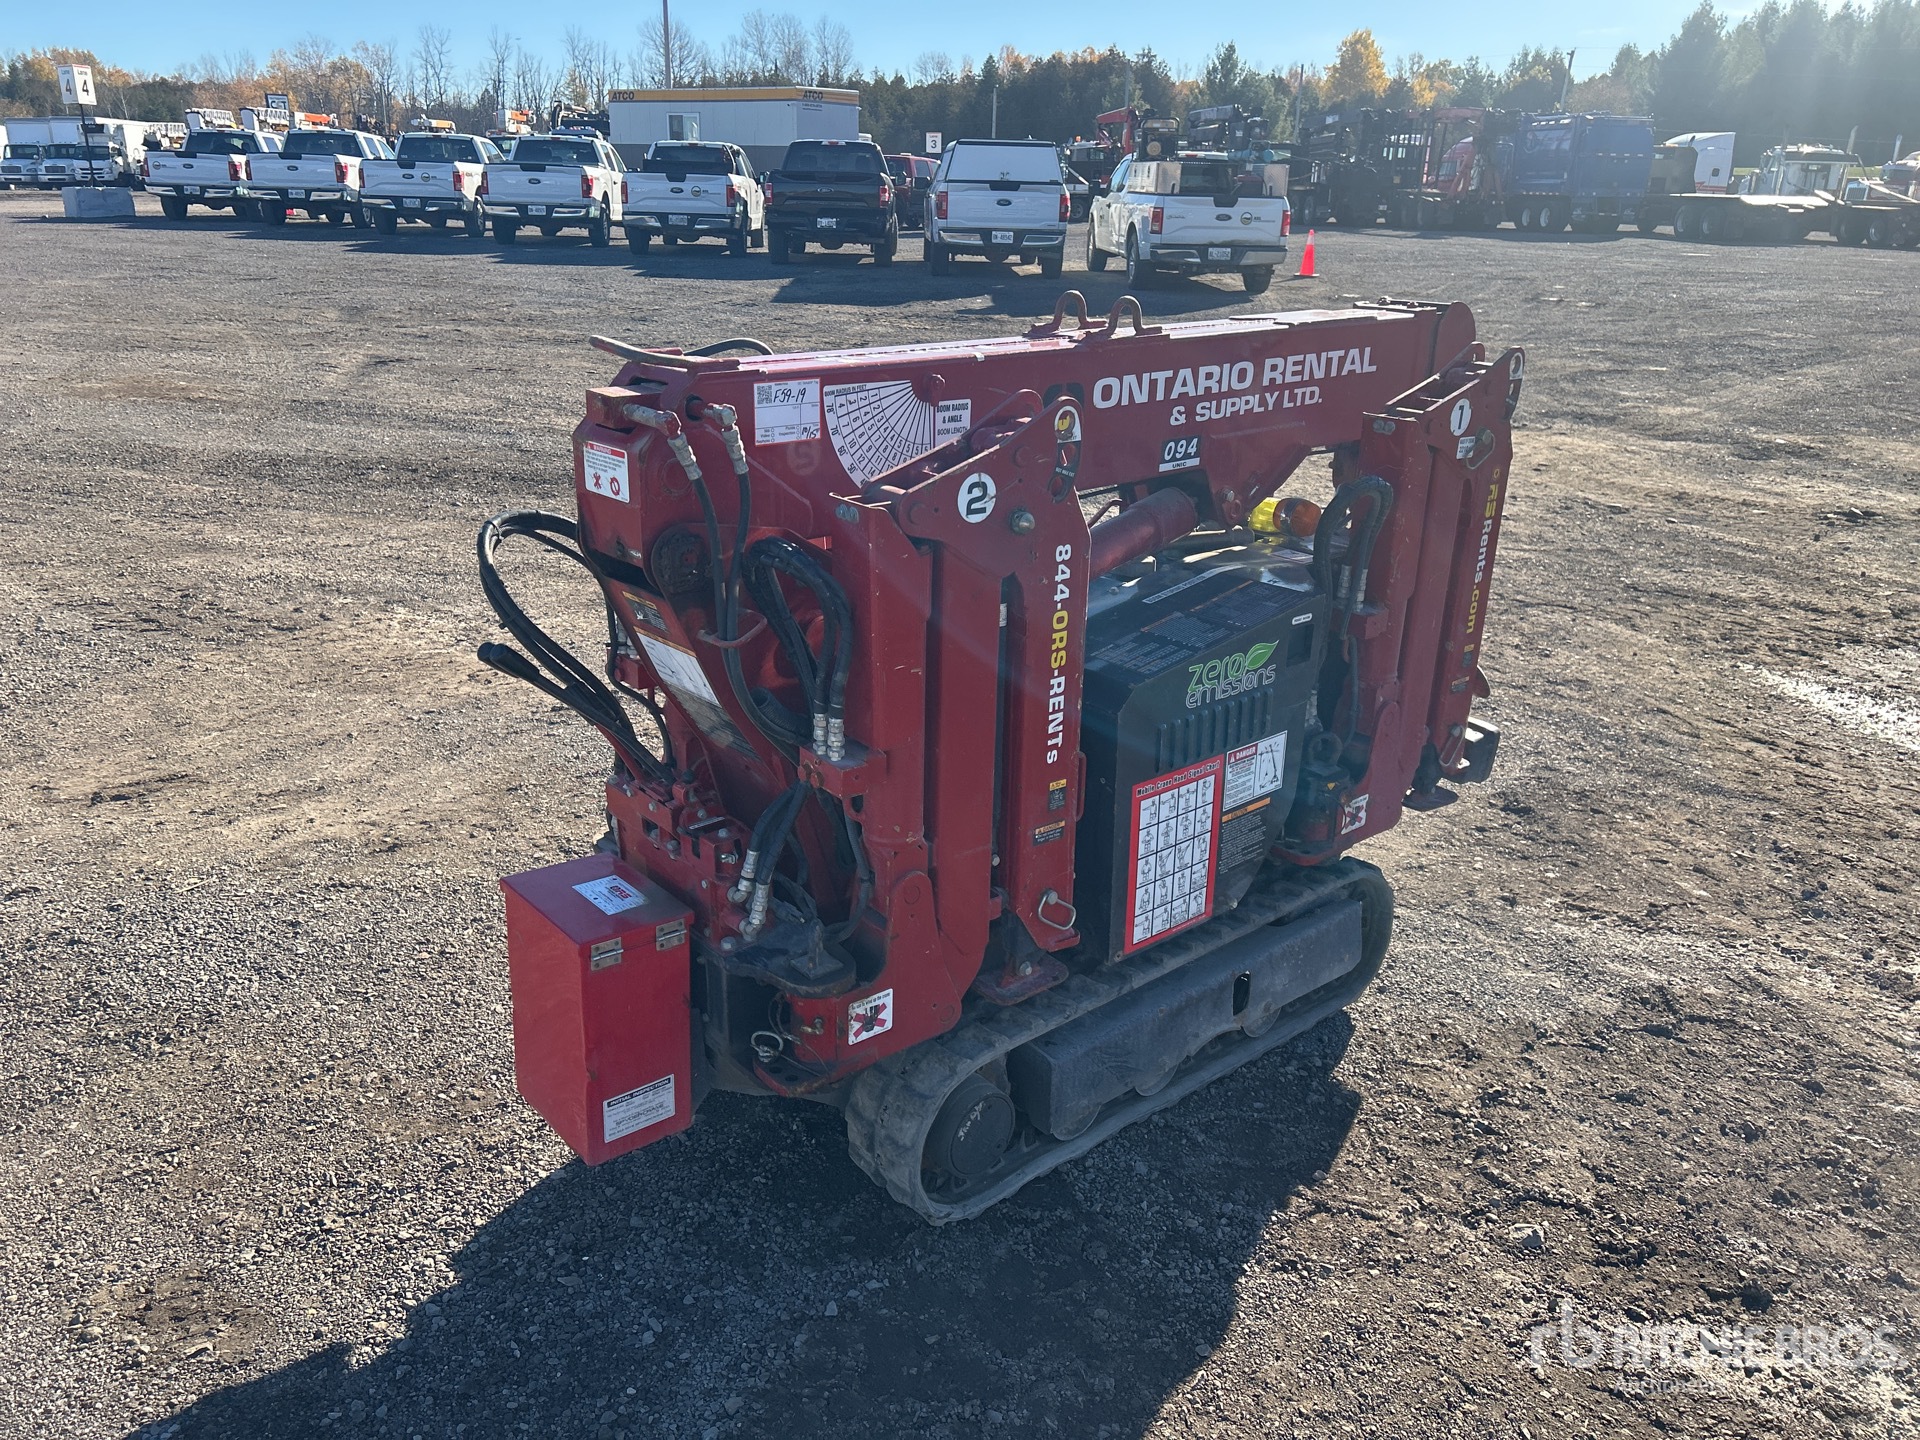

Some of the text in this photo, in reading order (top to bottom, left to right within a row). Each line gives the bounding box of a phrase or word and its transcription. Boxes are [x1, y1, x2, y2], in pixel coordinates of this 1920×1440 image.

[65, 78, 72, 95] 4
[82, 79, 89, 96] 4
[611, 91, 635, 101] ATCO
[802, 90, 824, 100] ATCO
[930, 139, 937, 149] 3
[1092, 346, 1377, 409] ONTARIO RENTAL
[773, 387, 806, 403] F59-19
[1169, 386, 1323, 426] & SUPPLY LTD.
[937, 402, 969, 413] BOOM RADIUS
[947, 415, 963, 423] ANGLE
[1458, 405, 1465, 430] 1
[867, 423, 876, 431] 5
[874, 434, 881, 442] 7
[882, 444, 889, 453] 8
[877, 415, 884, 423] 3
[883, 425, 890, 433] 4
[906, 443, 911, 453] 5
[937, 427, 951, 436] BOOM
[848, 438, 857, 449] 10
[857, 453, 866, 464] 12
[858, 431, 866, 439] 8
[875, 455, 883, 466] 11
[1164, 437, 1199, 461] 094
[1172, 461, 1187, 469] UNIC
[966, 481, 988, 516] 2
[1187, 652, 1246, 693] zero
[1185, 664, 1277, 709] emissions
[1235, 746, 1256, 761] DANGER
[1136, 760, 1221, 798] Mobile Crane Hand Signal Chart
